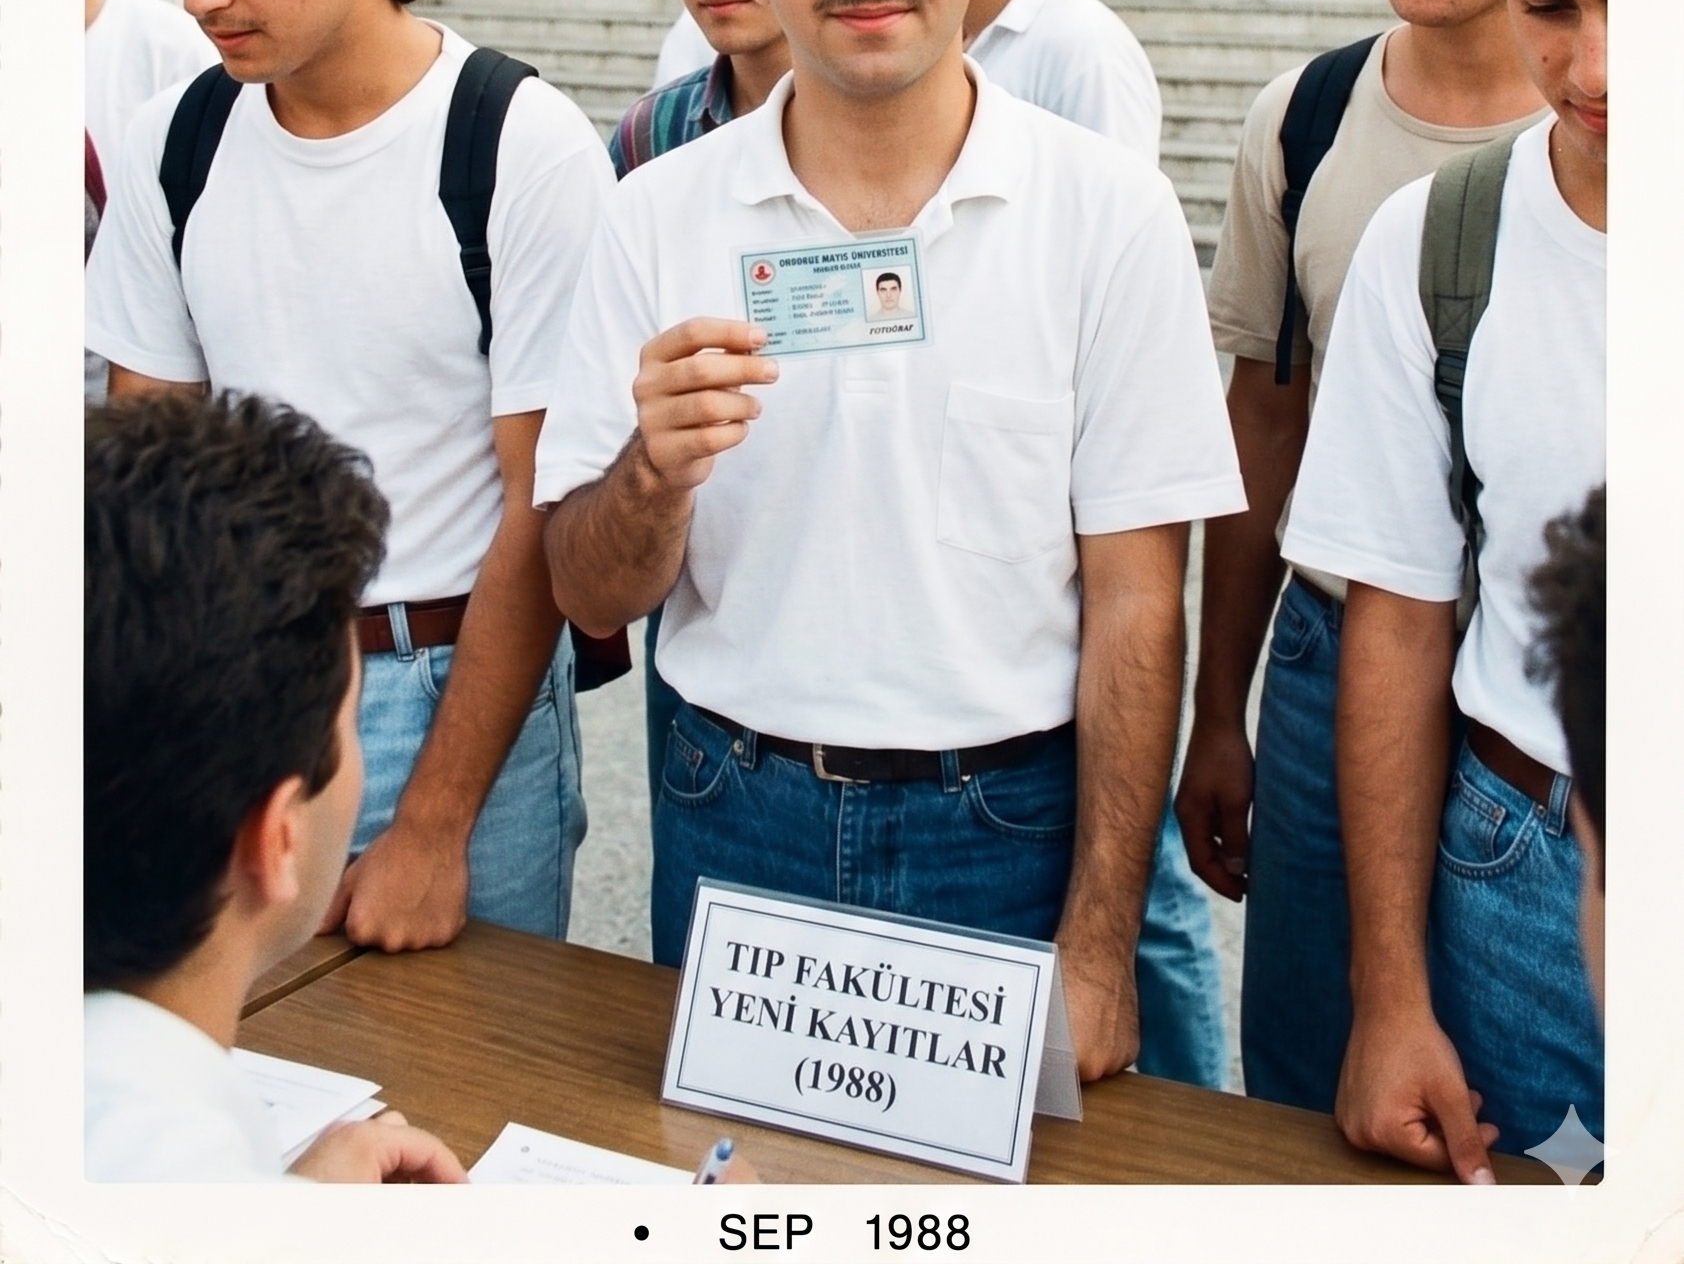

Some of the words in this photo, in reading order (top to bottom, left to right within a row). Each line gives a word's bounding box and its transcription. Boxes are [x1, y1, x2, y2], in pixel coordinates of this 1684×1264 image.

[726, 940, 785, 979] TIP
[793, 954, 1008, 1026] FAKÜLTESİ
[709, 986, 797, 1034] YENİ
[806, 1007, 1007, 1078] KAYITLAR
[794, 1056, 897, 1113] (1988)
